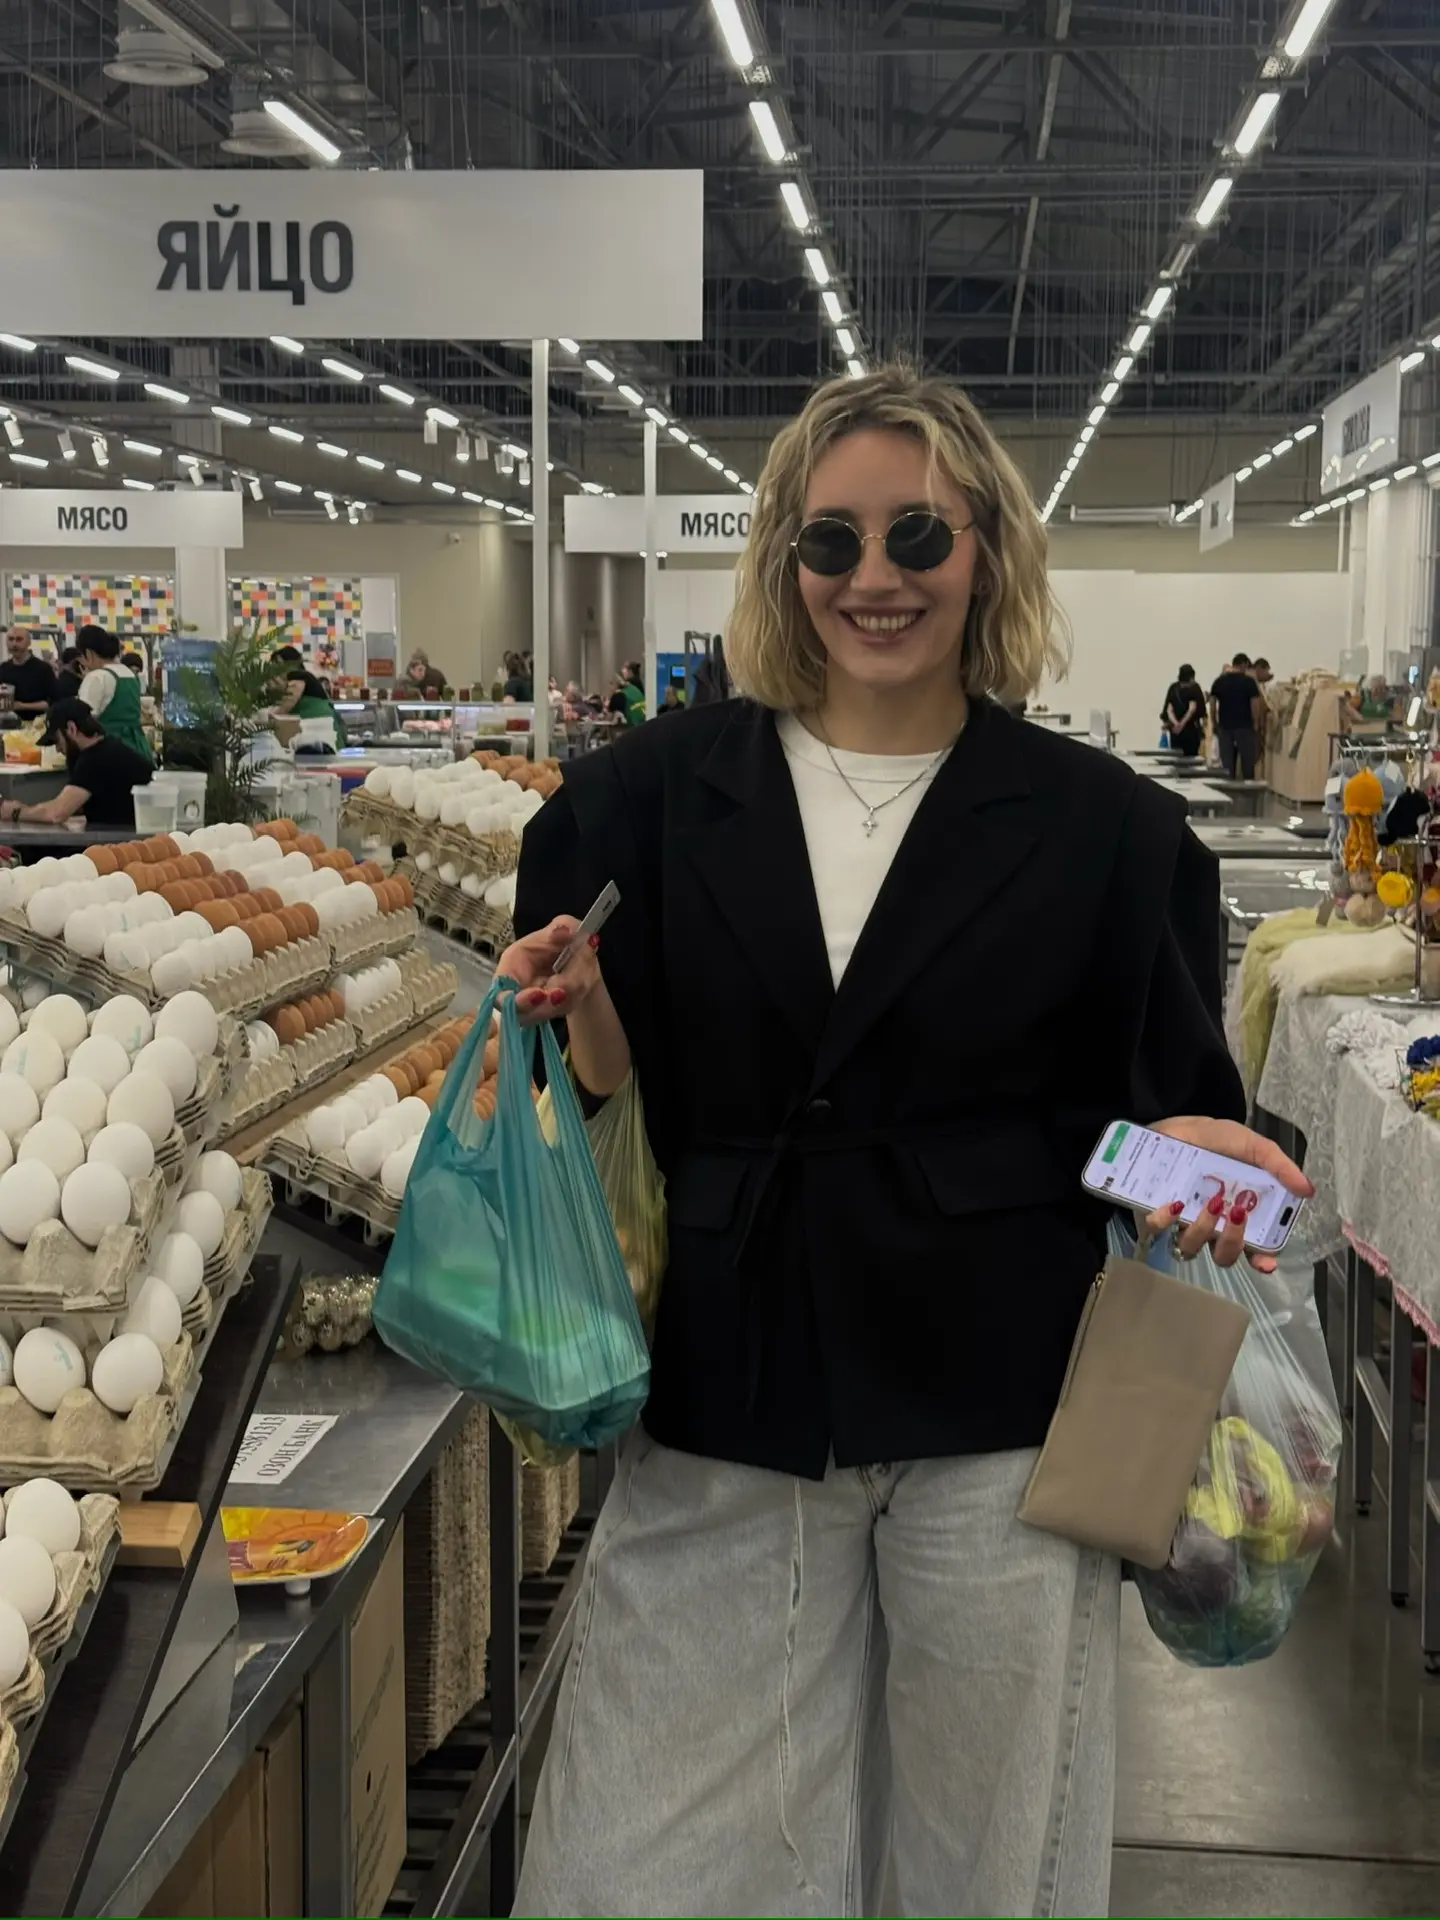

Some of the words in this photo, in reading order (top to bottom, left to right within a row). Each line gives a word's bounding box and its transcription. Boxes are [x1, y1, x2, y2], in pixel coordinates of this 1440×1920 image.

[156, 203, 354, 305] ЯЙЦО
[57, 506, 128, 531] МЯСО
[681, 512, 751, 538] МЯСО
[256, 1449, 300, 1477] ОЗОН
[283, 1419, 328, 1447] БАНК
